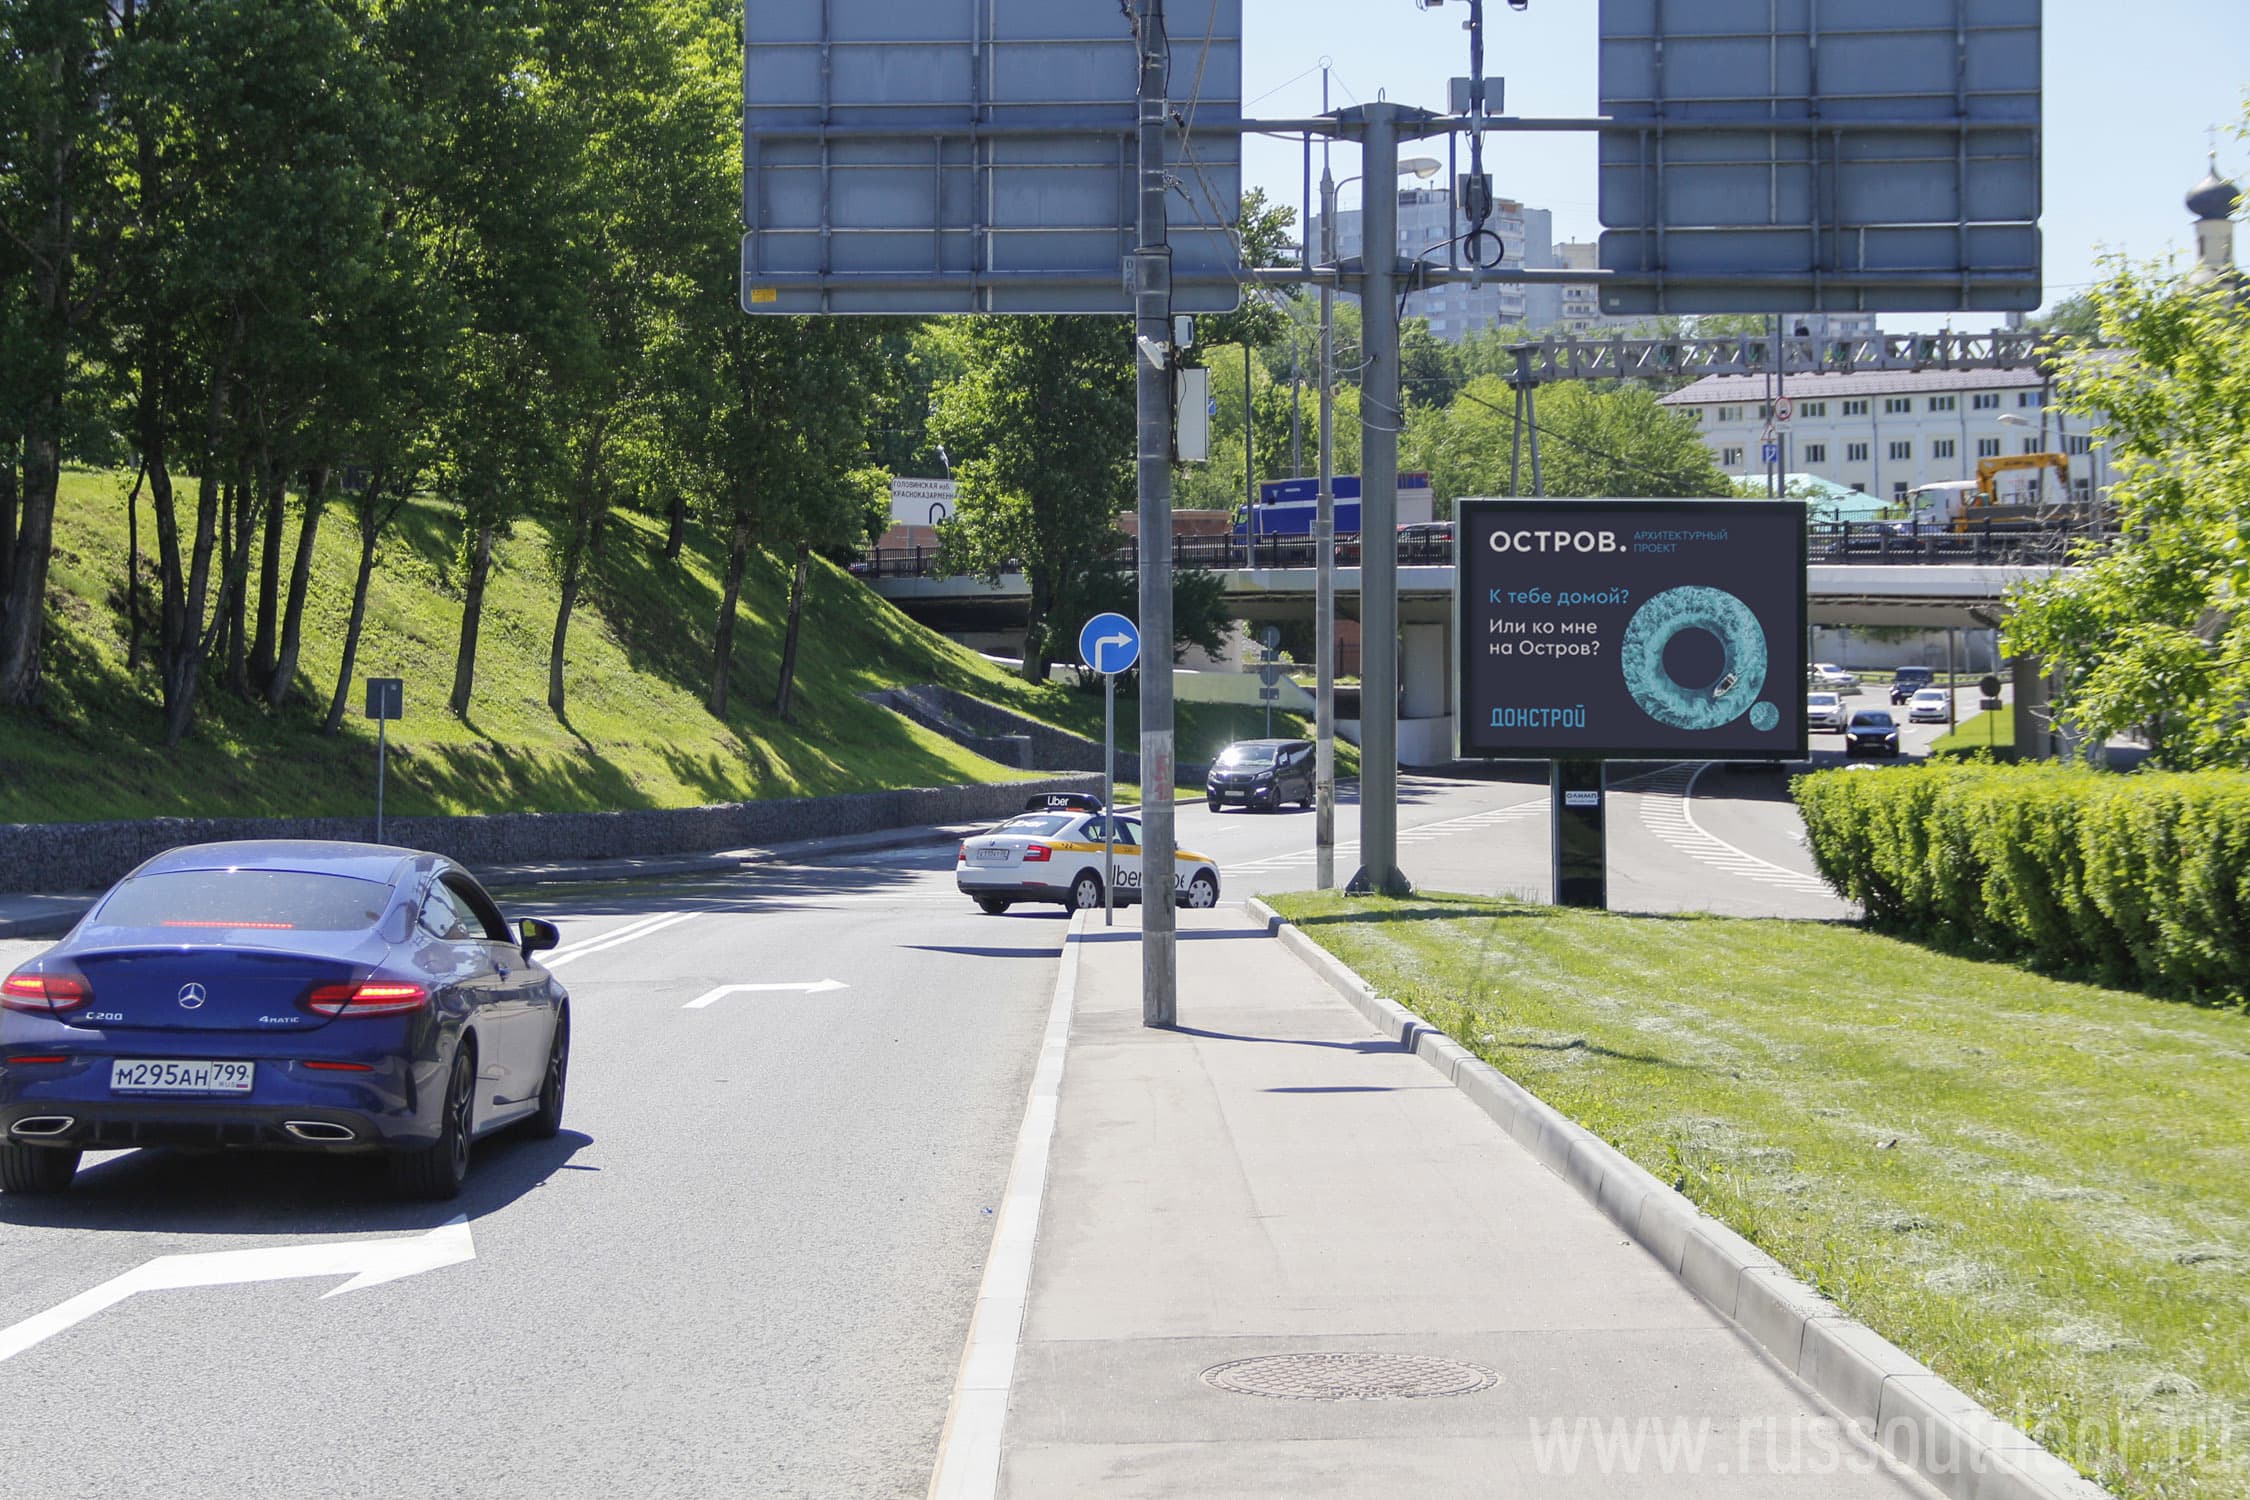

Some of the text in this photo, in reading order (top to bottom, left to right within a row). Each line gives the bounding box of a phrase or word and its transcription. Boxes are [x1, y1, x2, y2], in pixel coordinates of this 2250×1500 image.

[893, 481, 938, 489] ГОЛОВИНСКАЯ
[1489, 530, 1627, 553] ОСТРОВ.
[1633, 529, 1728, 541] АРХИТЕКТУРНЫЙ
[1633, 543, 1677, 553] ПРОЕКТ
[1489, 586, 1630, 607] К тебе домой?
[1489, 618, 1598, 634] Или ко мне
[1489, 639, 1601, 659] на Остров?
[1489, 703, 1586, 728] ДОНСТРОЙ
[1047, 795, 1069, 807] Uber
[213, 1063, 248, 1081] 799
